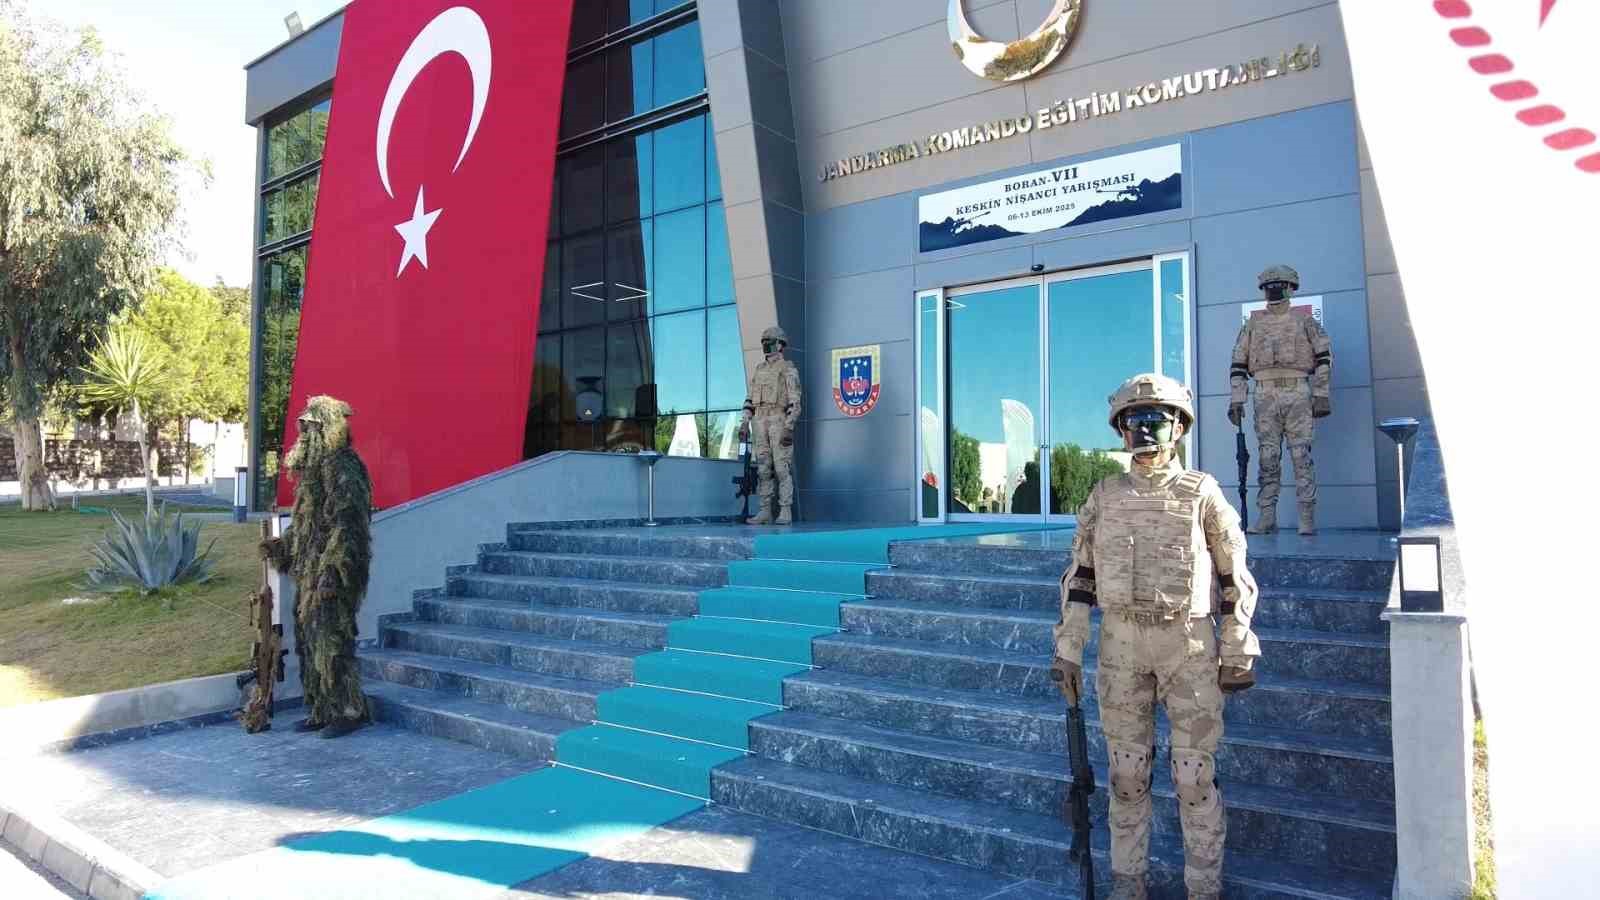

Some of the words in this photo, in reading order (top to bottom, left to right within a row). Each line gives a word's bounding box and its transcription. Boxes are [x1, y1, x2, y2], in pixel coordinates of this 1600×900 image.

[817, 138, 921, 182] JANDARMA
[925, 115, 1033, 156] KOMANDO
[1037, 91, 1122, 129] EĞİTİM
[1125, 43, 1321, 109] KOMUTANLIĞI
[1004, 167, 1078, 192] BORAN-VII
[1006, 187, 1057, 206] NİŞANCI
[1062, 173, 1135, 194] YARIŞMASI
